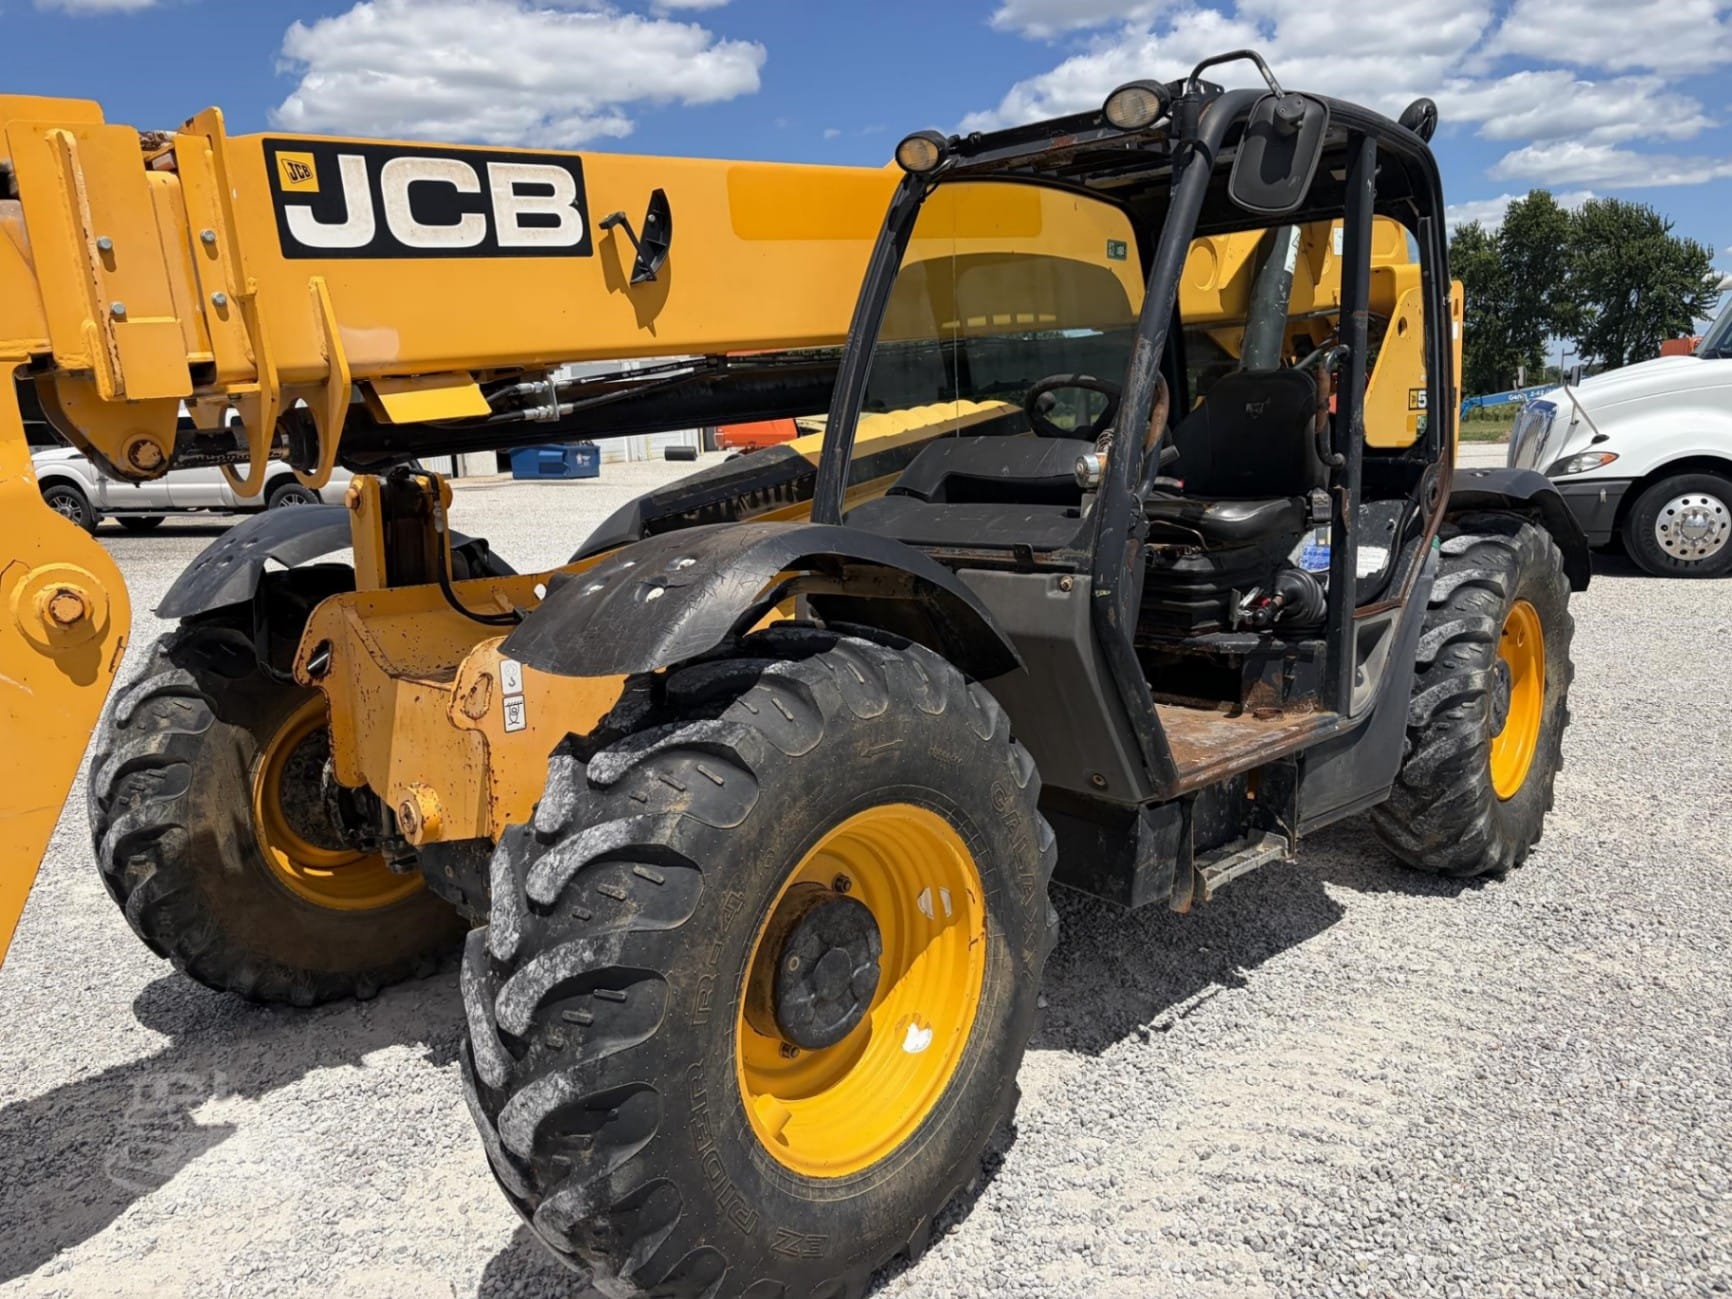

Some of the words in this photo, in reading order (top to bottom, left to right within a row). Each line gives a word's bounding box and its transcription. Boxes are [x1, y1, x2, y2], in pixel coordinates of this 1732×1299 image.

[284, 153, 584, 249] JCB
[288, 161, 311, 181] JCB
[990, 780, 1036, 984] GALAXY
[686, 1056, 761, 1236] RIDER
[770, 1225, 829, 1260] EZ
